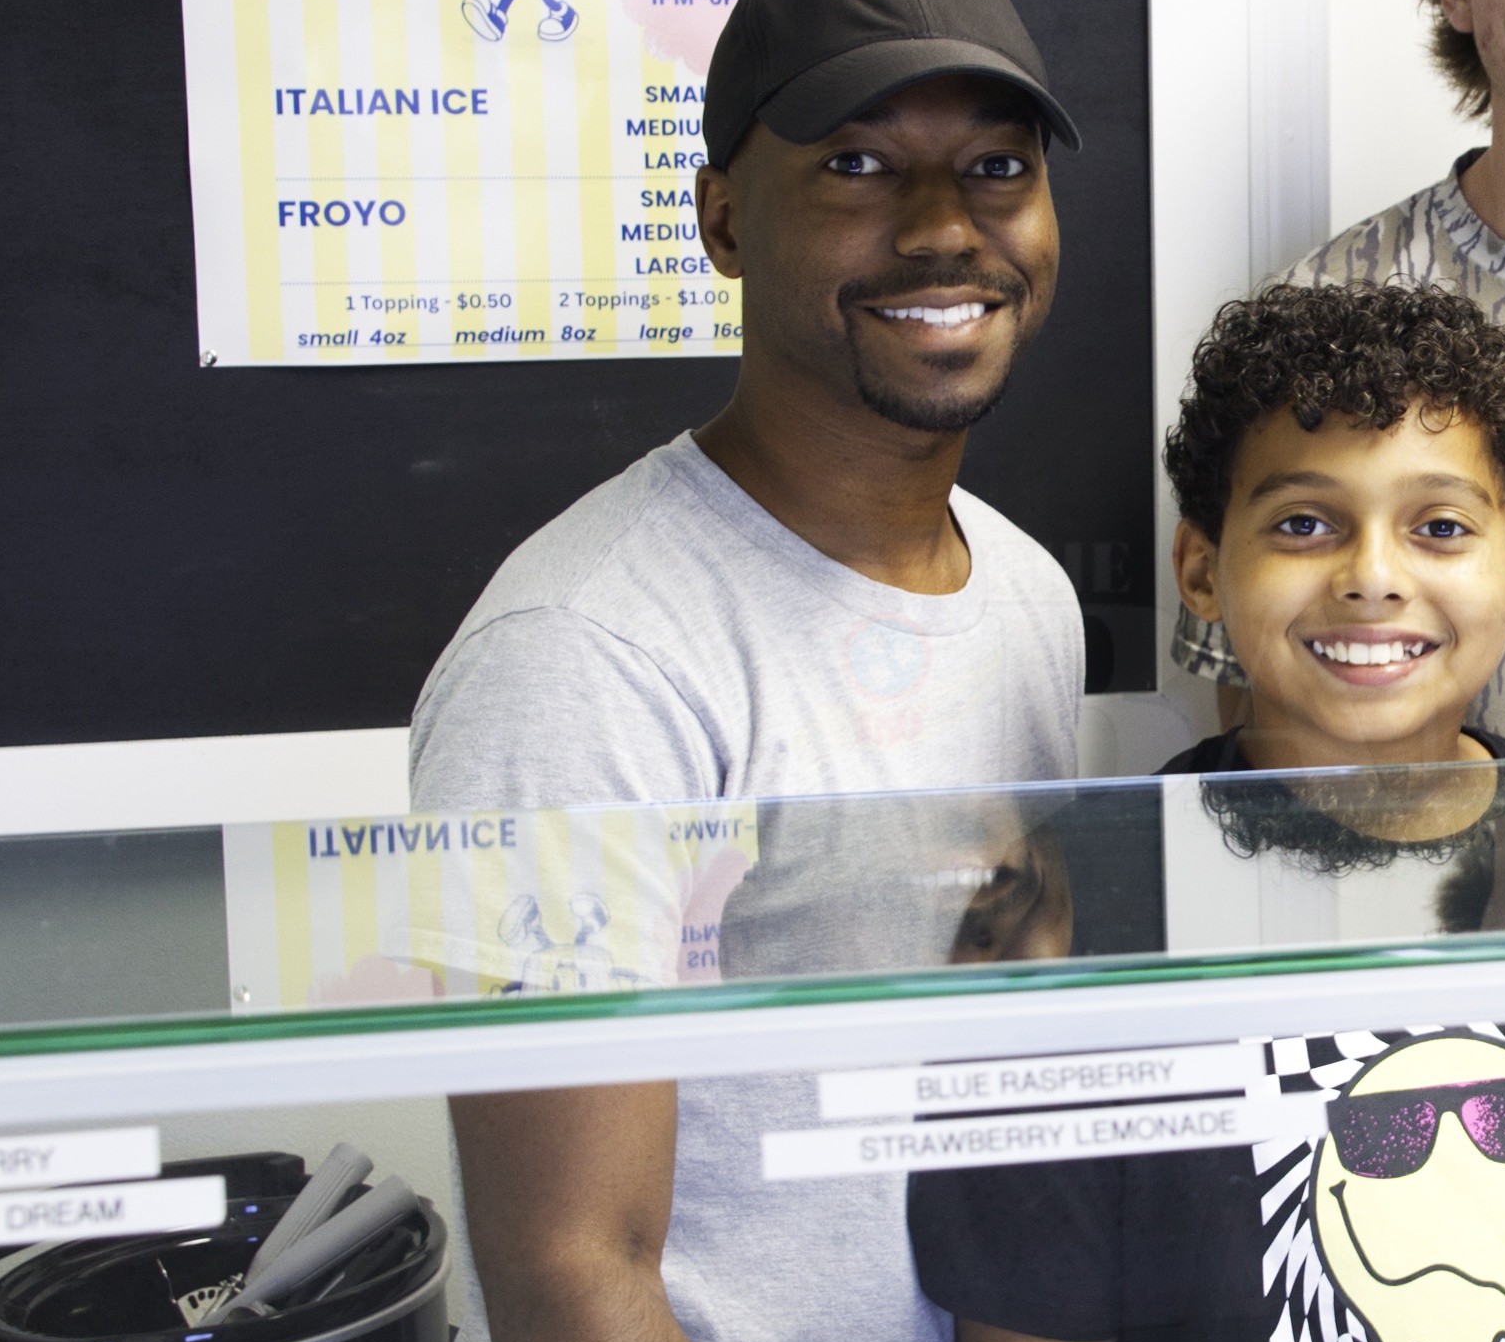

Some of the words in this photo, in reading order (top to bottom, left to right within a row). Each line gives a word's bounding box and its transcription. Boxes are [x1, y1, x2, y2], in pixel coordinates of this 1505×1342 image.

[275, 89, 419, 115] ITALIAN
[431, 89, 489, 115] ICE
[626, 120, 705, 136] MEDIU
[645, 153, 708, 169] LARG
[640, 191, 695, 207] SMA
[278, 201, 406, 227] FROYO
[621, 224, 702, 241] MEDIU
[635, 258, 711, 274] LARGE
[346, 295, 354, 311] 1
[363, 294, 438, 315] Topping
[456, 292, 512, 312] $0.50
[559, 293, 569, 309] 2
[575, 292, 660, 312] Toppings
[677, 288, 730, 308] $1.00
[298, 327, 358, 346] small
[370, 326, 407, 345] 4oz
[455, 324, 545, 344] medium
[561, 324, 597, 342] 8oz
[639, 322, 693, 344] large
[713, 322, 743, 339] 16o
[917, 1075, 990, 1102] BLUE
[999, 1060, 1175, 1094] RASPBERRY
[860, 1125, 1065, 1162] STRAWBERRY
[1075, 1111, 1237, 1145] LEMONADE
[6, 1198, 124, 1232] DREAM
